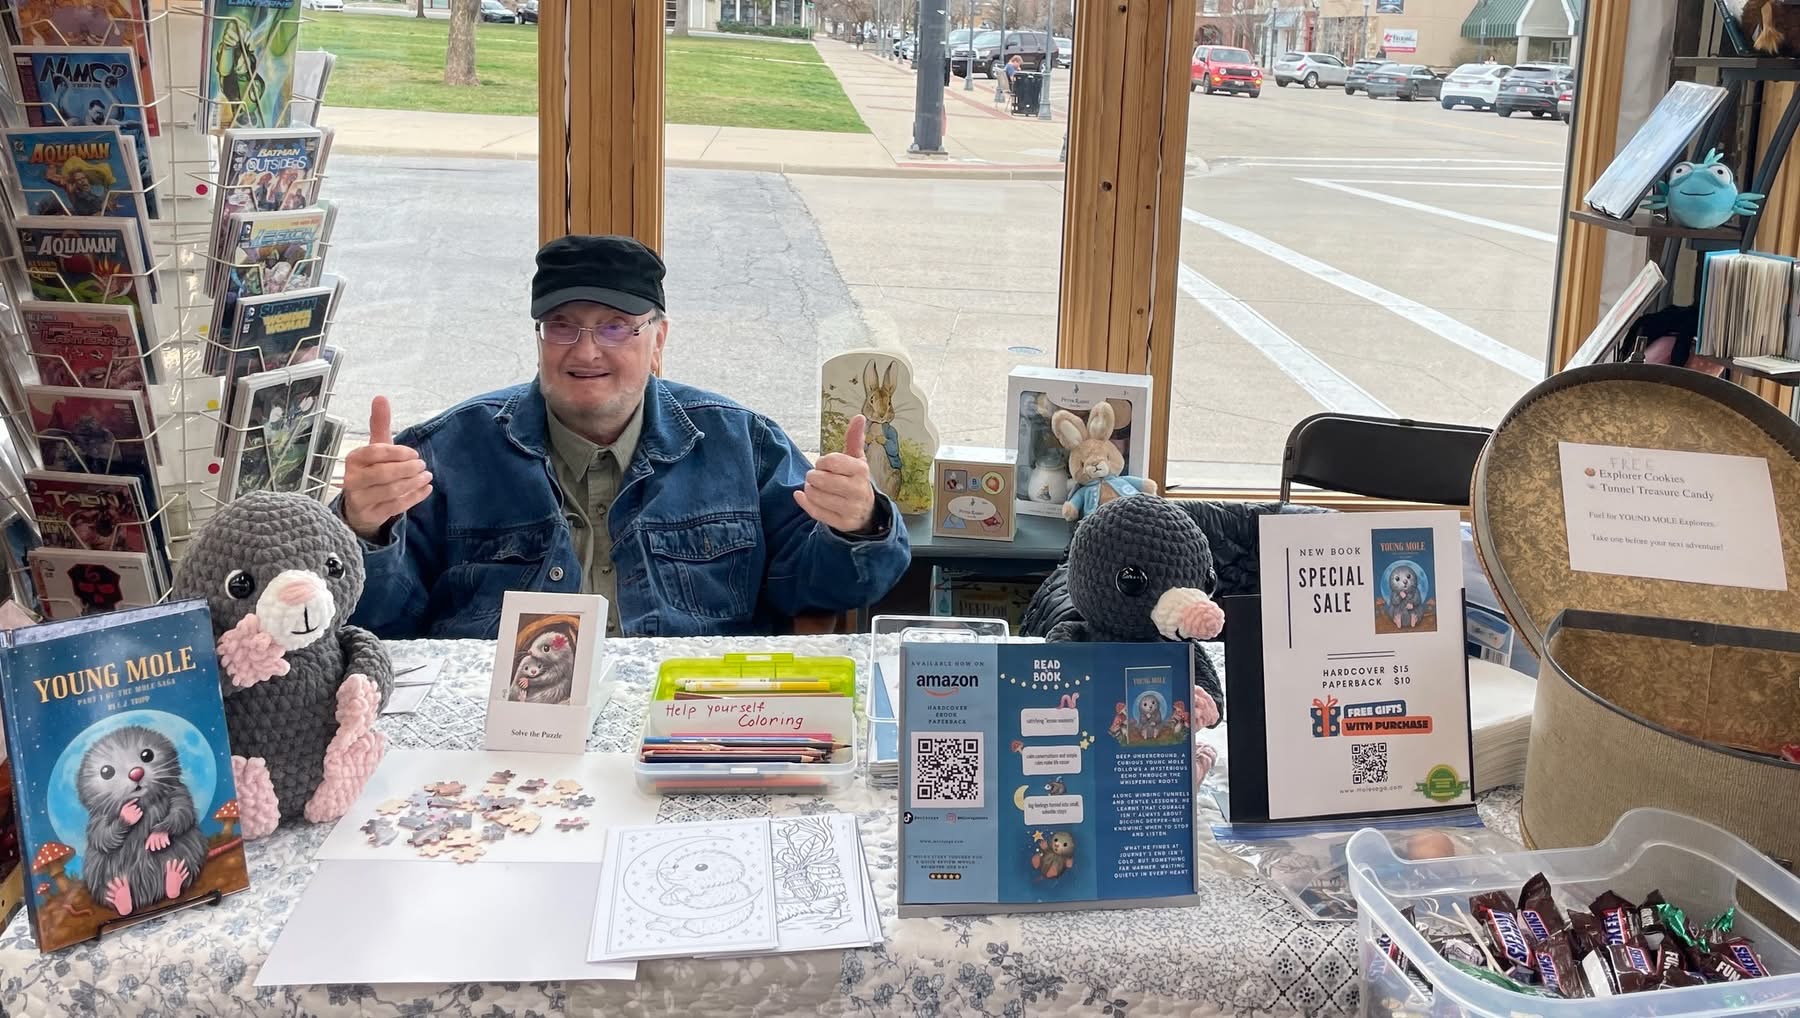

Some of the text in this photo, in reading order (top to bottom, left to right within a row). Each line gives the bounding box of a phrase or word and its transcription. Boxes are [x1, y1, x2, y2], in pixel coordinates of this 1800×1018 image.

[30, 143, 110, 163] AQUAMAN
[257, 148, 301, 158] BATMAN
[38, 236, 116, 258] AQUAMAN
[1608, 456, 1658, 471] FREE
[1599, 470, 1685, 484] Explorer Cookies
[1600, 484, 1714, 501] Tunnel Treasure Candy
[1588, 511, 1605, 519] Fuel
[1652, 516, 1678, 524] MOLE
[1406, 542, 1424, 550] MOLE
[1591, 534, 1608, 542] Take
[1625, 536, 1648, 545] before
[1650, 540, 1666, 548] your
[1686, 542, 1724, 550] adventure!
[1331, 548, 1361, 556] BOOK
[1299, 566, 1364, 588] SPECIAL
[1314, 592, 1351, 614] SALE
[1034, 660, 1060, 669] READ
[1323, 664, 1409, 677] HARDCOVER $15
[32, 645, 196, 704] YOUNG MOLE
[916, 674, 979, 688] amazon
[1034, 672, 1061, 682] BOOK
[1322, 676, 1410, 688] PAPERBACK $10
[666, 703, 696, 719] Help
[1348, 704, 1402, 717] FREE GIFTS
[738, 714, 804, 730] Coloring
[1346, 720, 1428, 731] WITH PURCHASE
[1523, 911, 1549, 941] SNICK
[1733, 946, 1762, 977] CKERS
[1715, 960, 1742, 981] FUN
